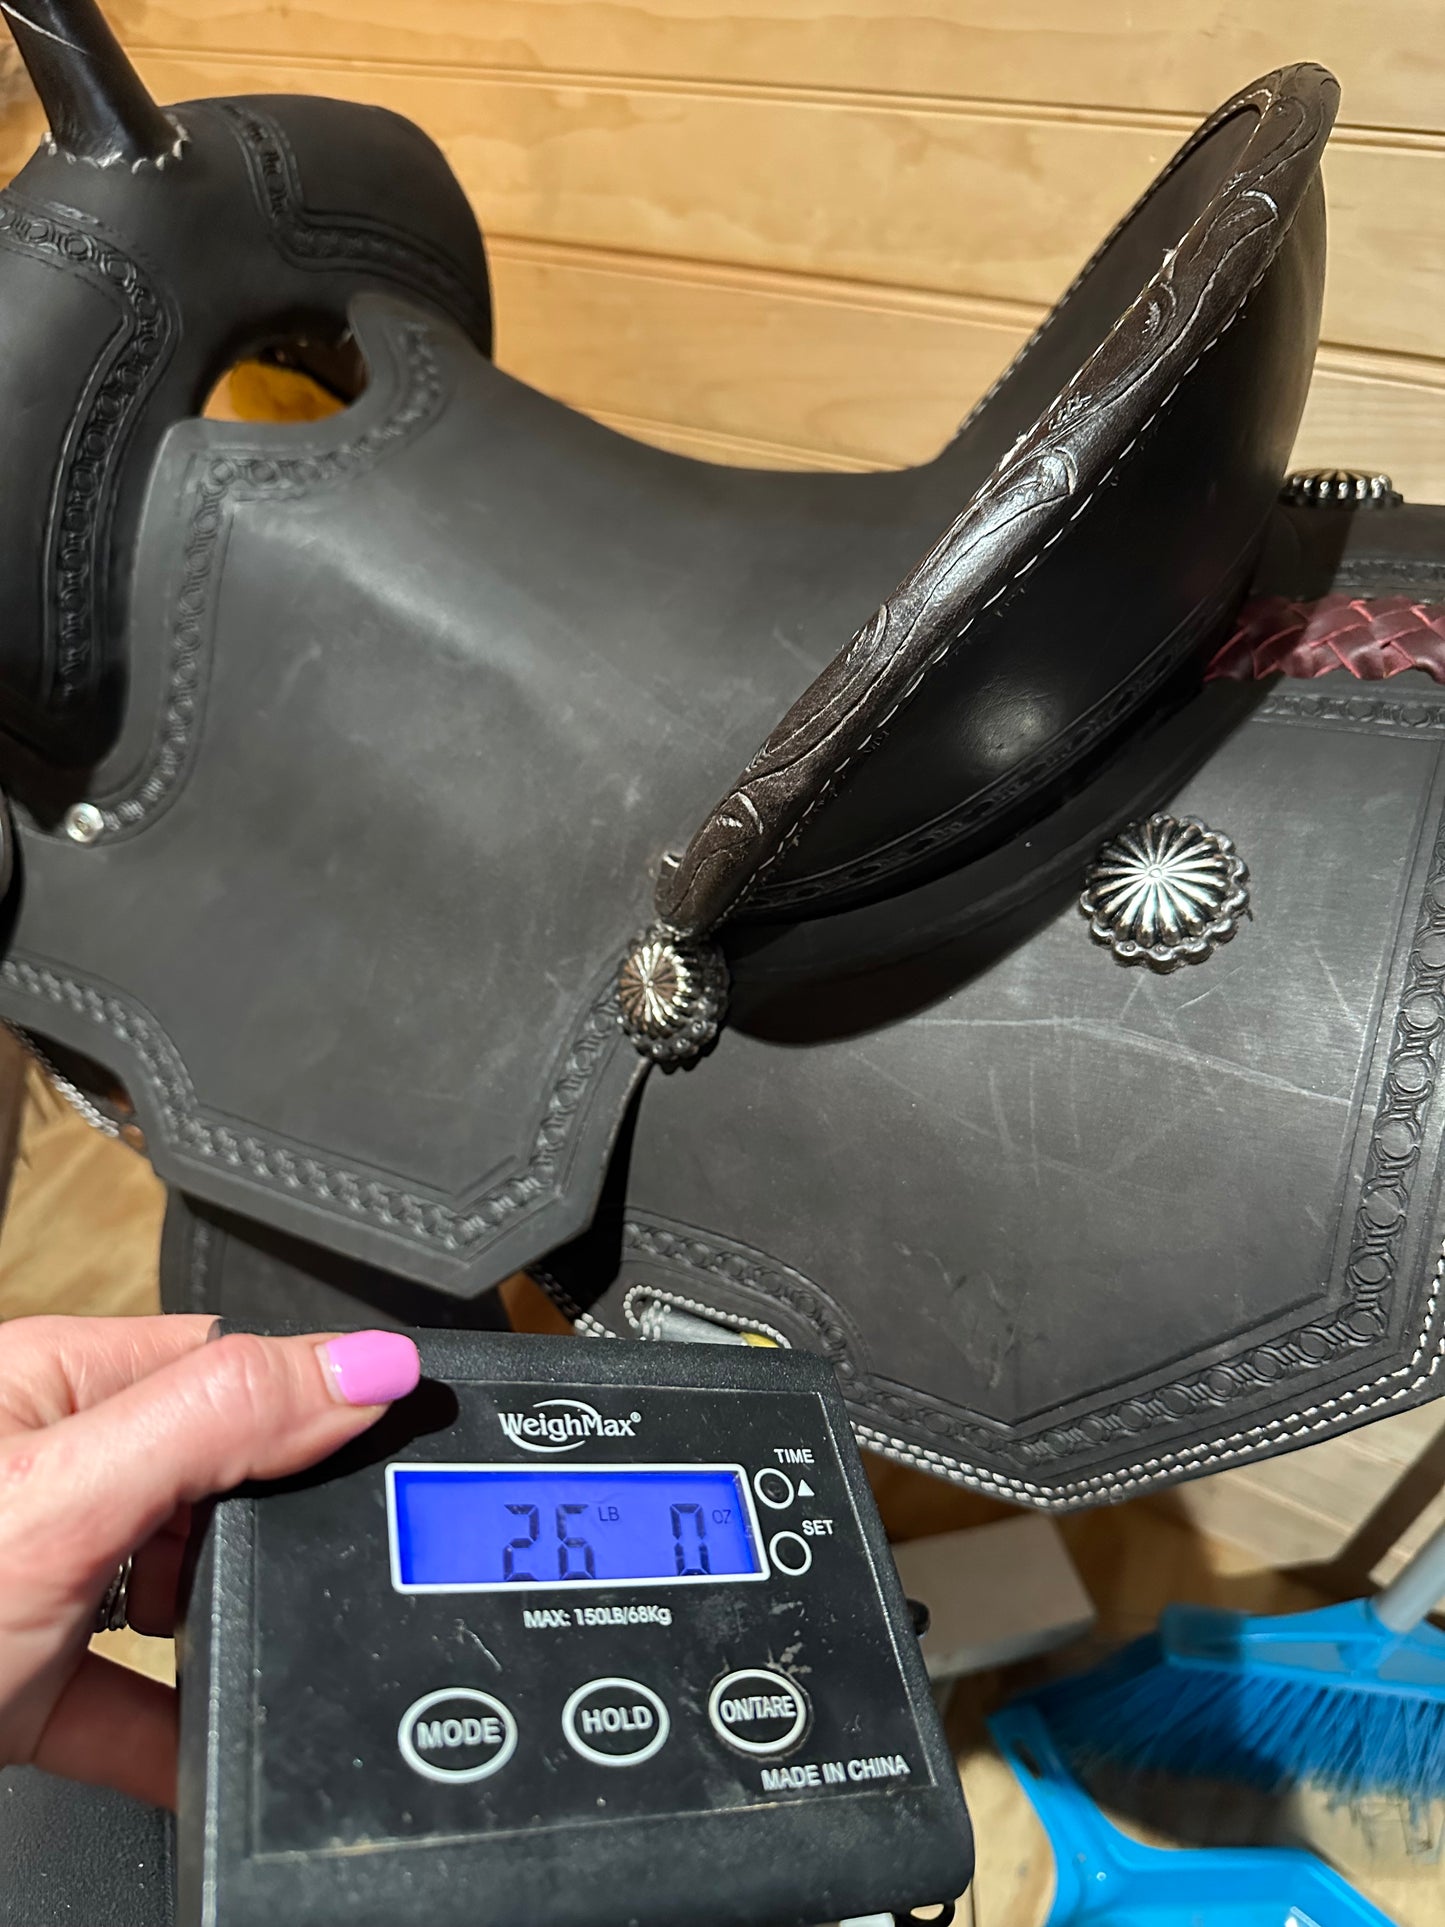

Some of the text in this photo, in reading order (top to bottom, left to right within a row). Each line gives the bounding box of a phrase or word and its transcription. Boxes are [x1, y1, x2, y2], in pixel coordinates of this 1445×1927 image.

[774, 1447, 815, 1464] TIME
[503, 1503, 597, 1582] 26
[598, 1506, 620, 1522] LB
[669, 1502, 711, 1577] 0
[803, 1519, 835, 1536] SET
[523, 1605, 672, 1629] MAX: 150LB/68Kg
[582, 1705, 654, 1734] HOLD
[719, 1694, 798, 1724] ON/TARE
[417, 1716, 502, 1749] MODE
[761, 1755, 911, 1791] MADE IN CHINA
